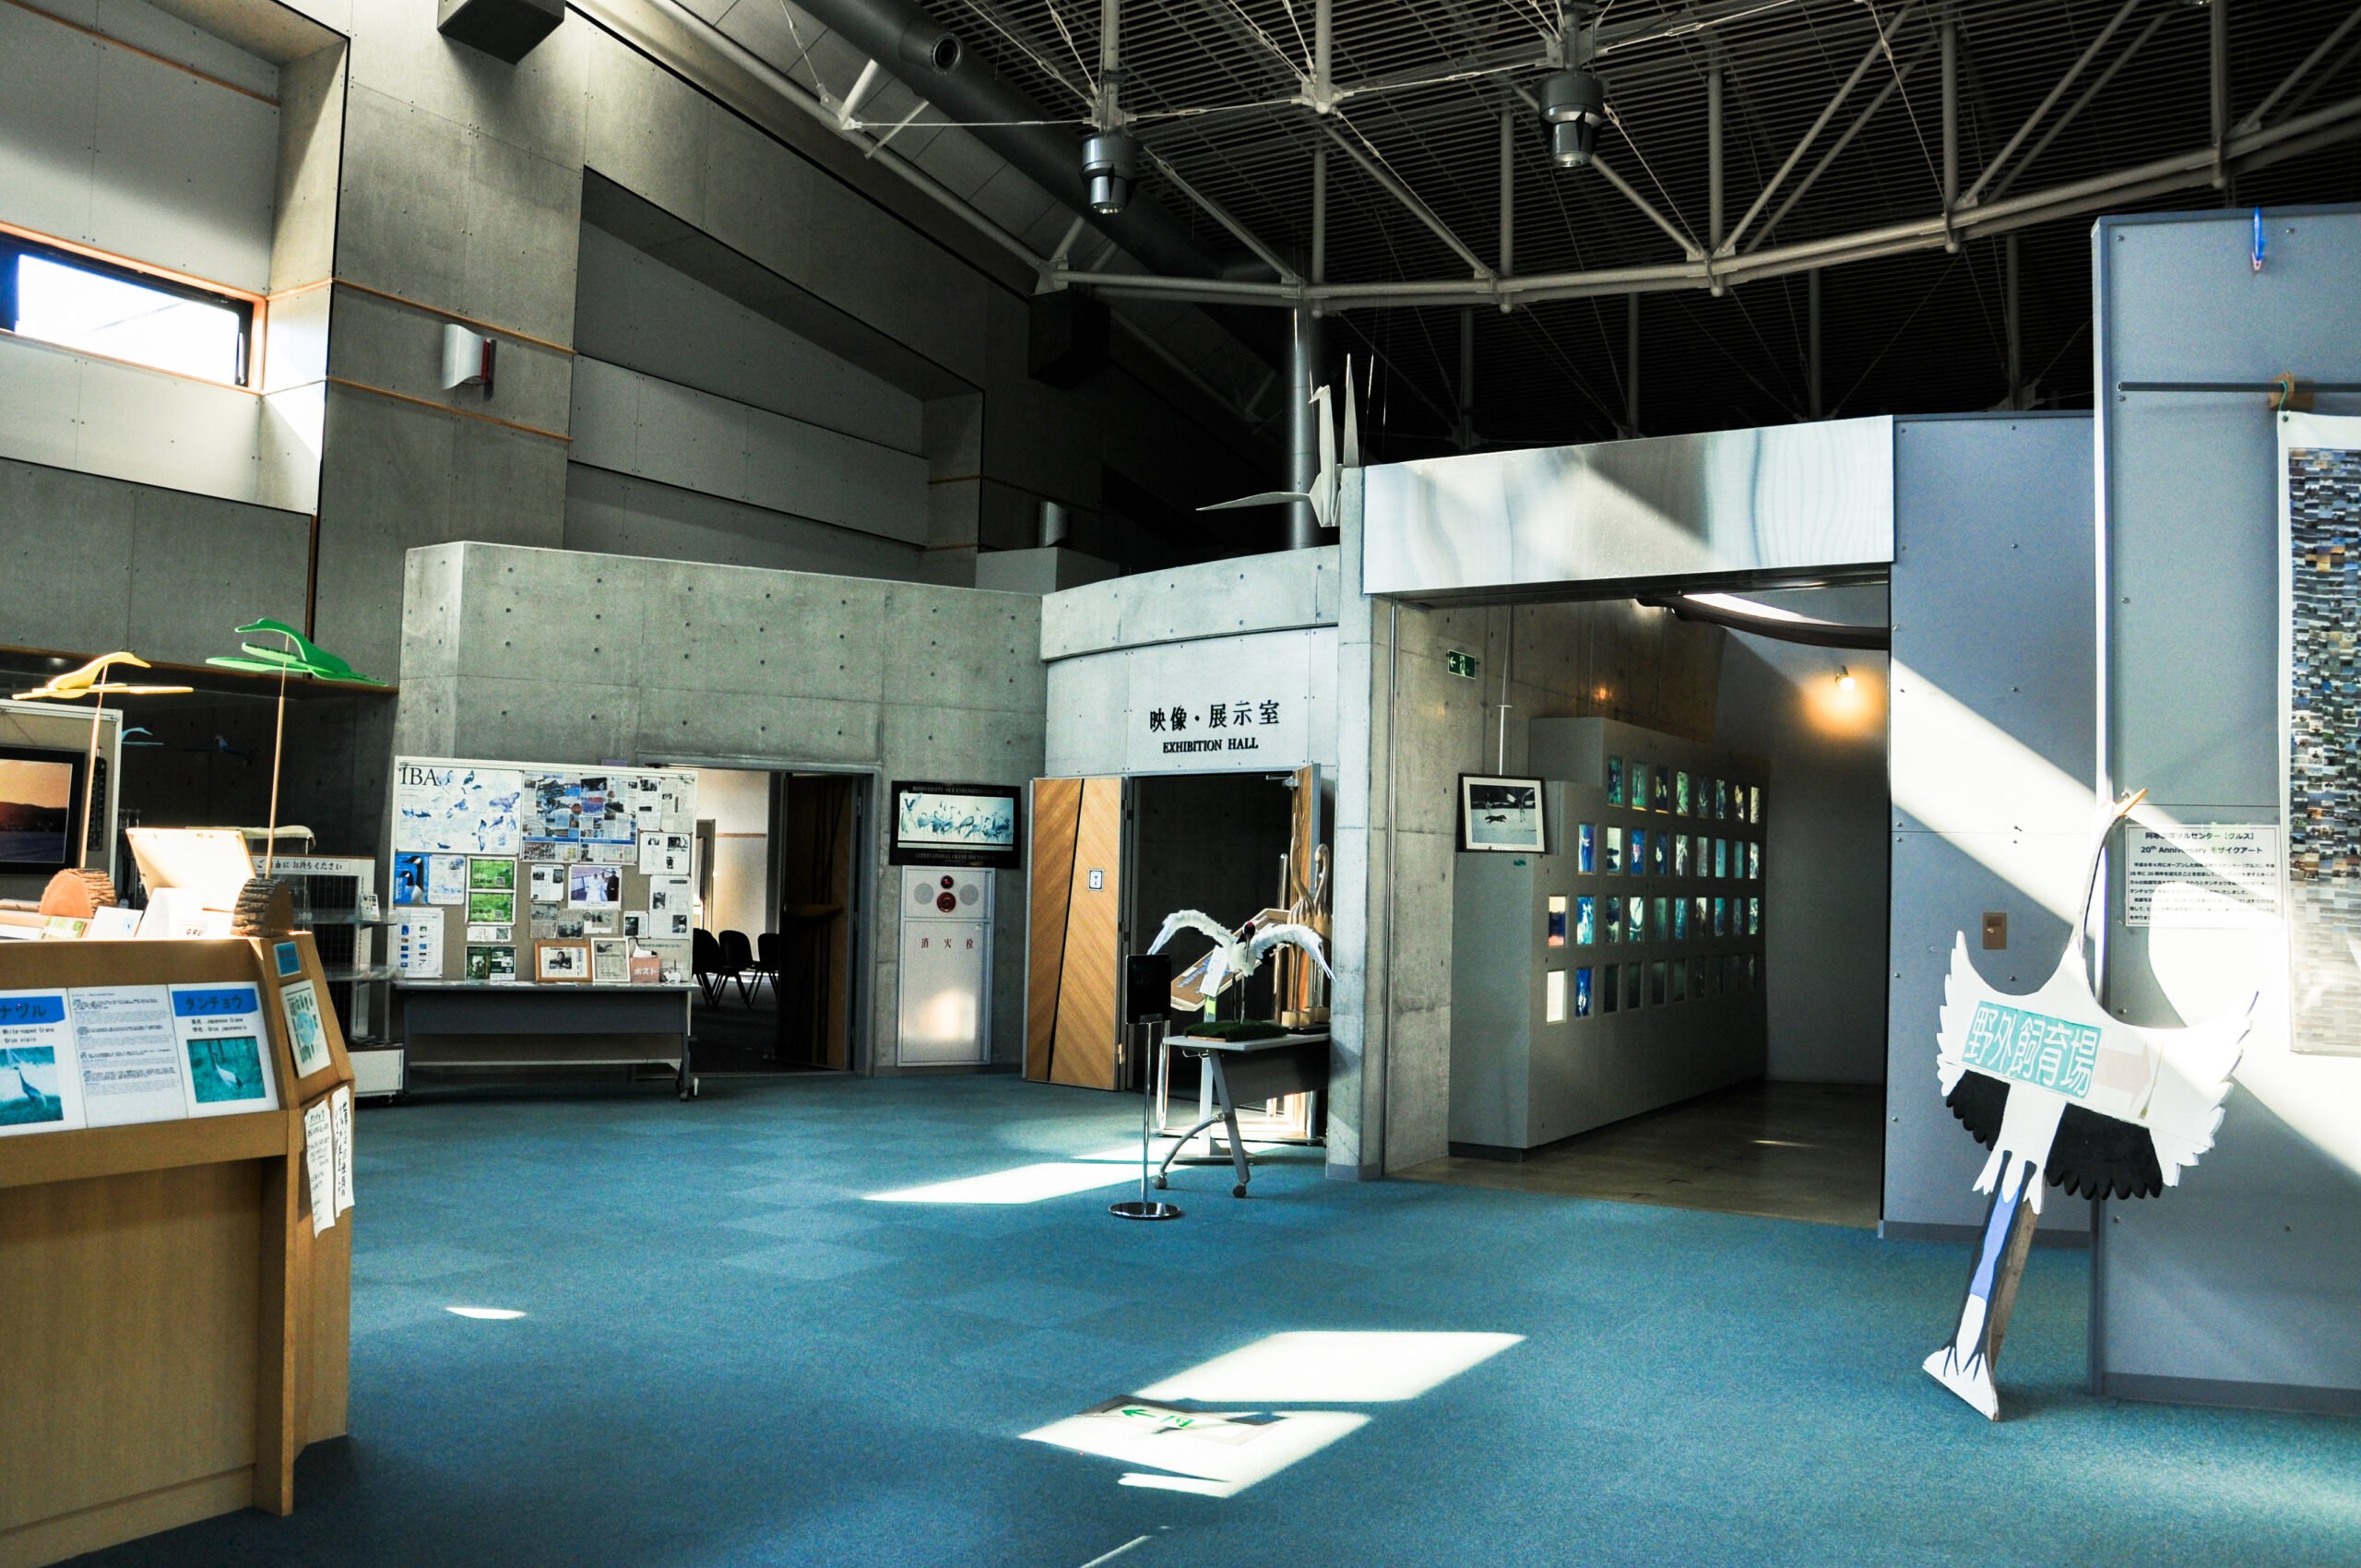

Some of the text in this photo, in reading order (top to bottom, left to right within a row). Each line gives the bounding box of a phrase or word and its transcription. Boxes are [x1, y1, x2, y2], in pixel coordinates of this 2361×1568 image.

[1149, 699, 1280, 732] 映像・展示室
[1162, 737, 1259, 754] EXHIBITION HALL
[400, 766, 438, 787] IBA
[2158, 846, 2207, 855] Annivrsary
[2211, 846, 2263, 854] モザイクアート
[257, 858, 342, 871] ご由にお持ちください
[921, 938, 974, 950] 消火栓
[184, 994, 243, 1012] タンチョウ
[1964, 1006, 2097, 1095] 野外飼育場
